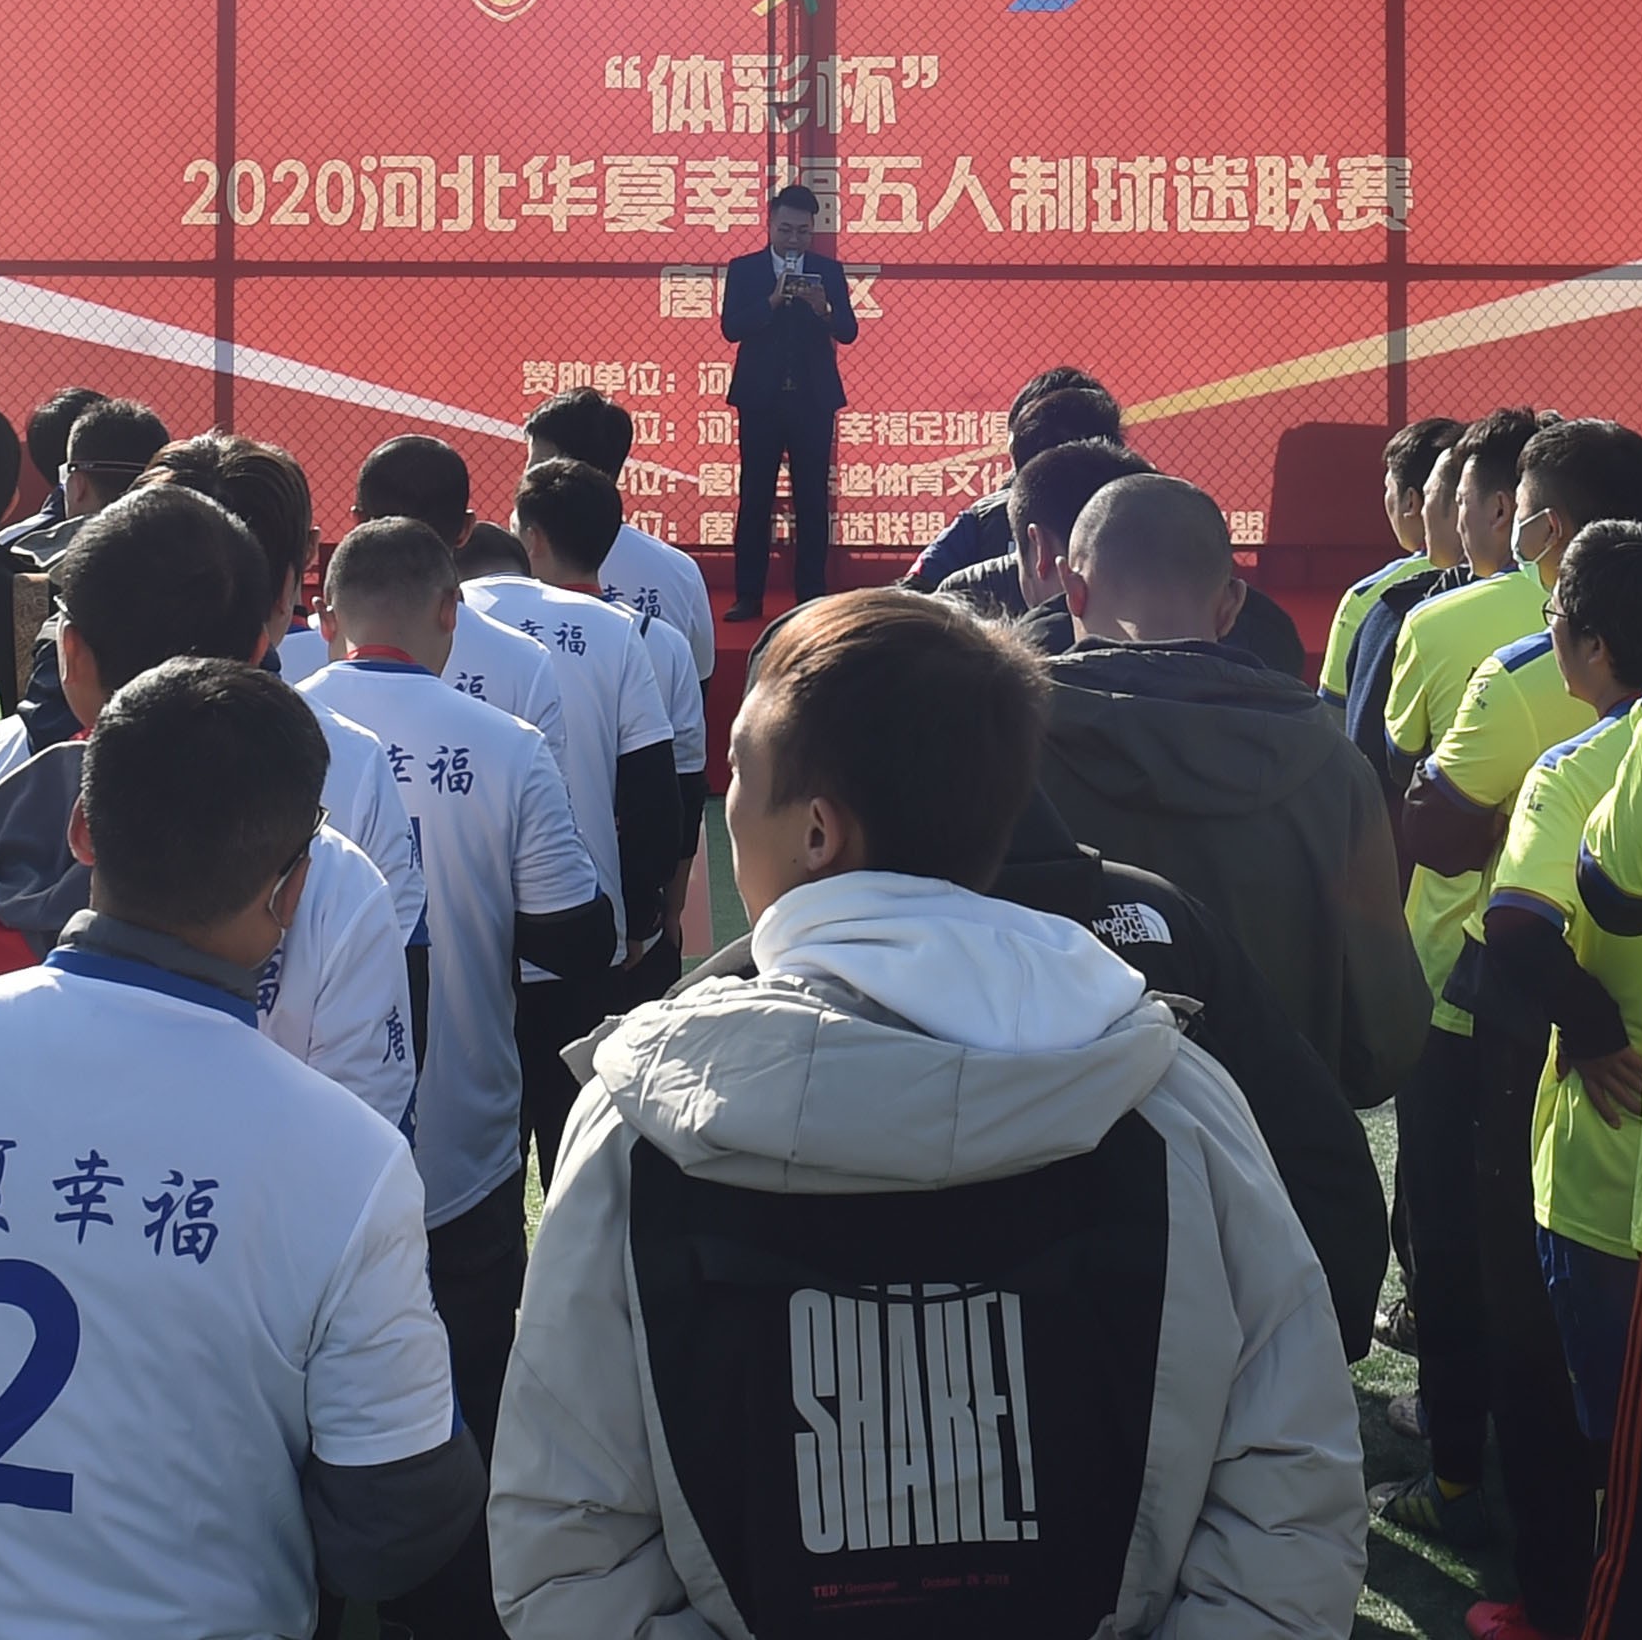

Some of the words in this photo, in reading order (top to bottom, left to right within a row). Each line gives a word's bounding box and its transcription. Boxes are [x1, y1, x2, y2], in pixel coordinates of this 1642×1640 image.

[603, 53, 940, 136] “体彩杯”
[659, 264, 884, 319] 唐区
[1091, 915, 1145, 936] NORTH
[1107, 903, 1140, 919] THE
[1111, 928, 1151, 947] FACE
[788, 1282, 1041, 1556] SHARE!
